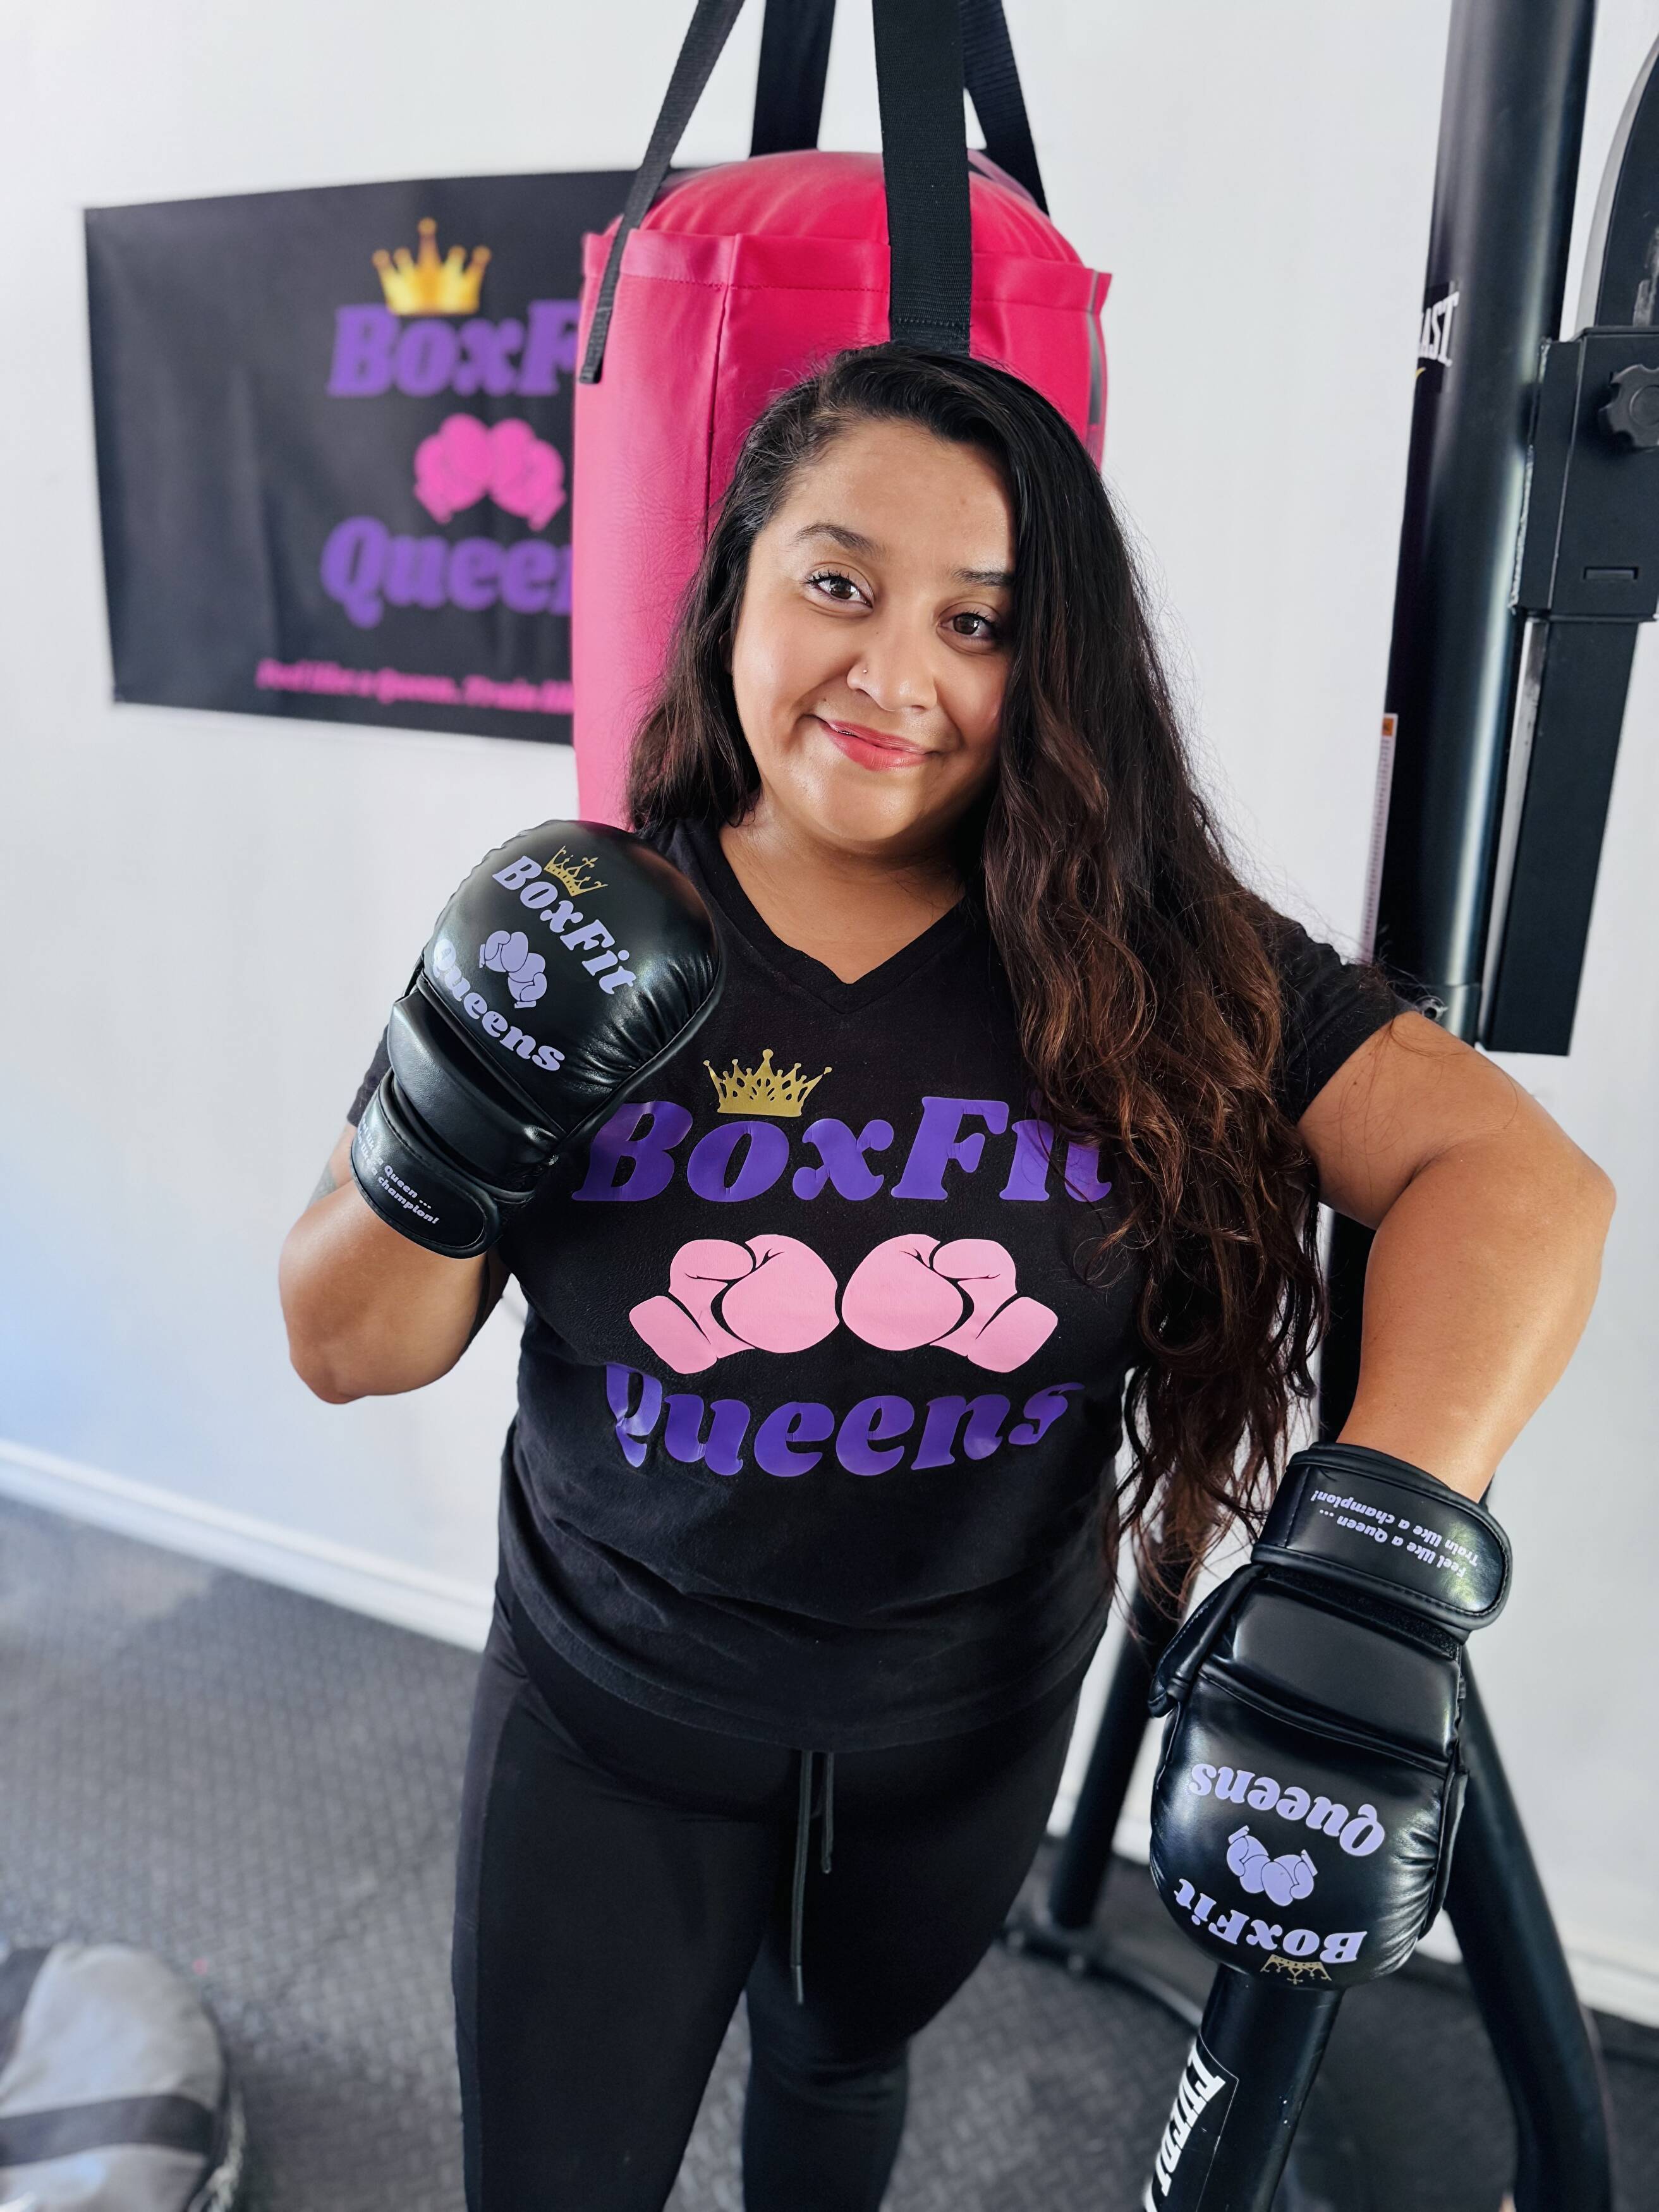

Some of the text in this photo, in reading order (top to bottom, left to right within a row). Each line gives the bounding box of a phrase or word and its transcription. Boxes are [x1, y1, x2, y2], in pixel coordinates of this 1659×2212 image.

[327, 299, 580, 398] BoxF
[320, 515, 574, 628] Quee
[492, 855, 636, 995] BoxFit
[433, 938, 565, 1071] Queens
[378, 1176, 440, 1224] champion!
[384, 1165, 418, 1198] Queen
[606, 1362, 1085, 1478] Queens
[1310, 1490, 1478, 1567] Train like a champion!
[1336, 1516, 1388, 1543] Queen
[1392, 1536, 1404, 1547] a
[1406, 1541, 1437, 1564] like
[1436, 1555, 1466, 1577] Feel
[1191, 1763, 1385, 1857] Queens
[1174, 1879, 1366, 1964] BoxFit
